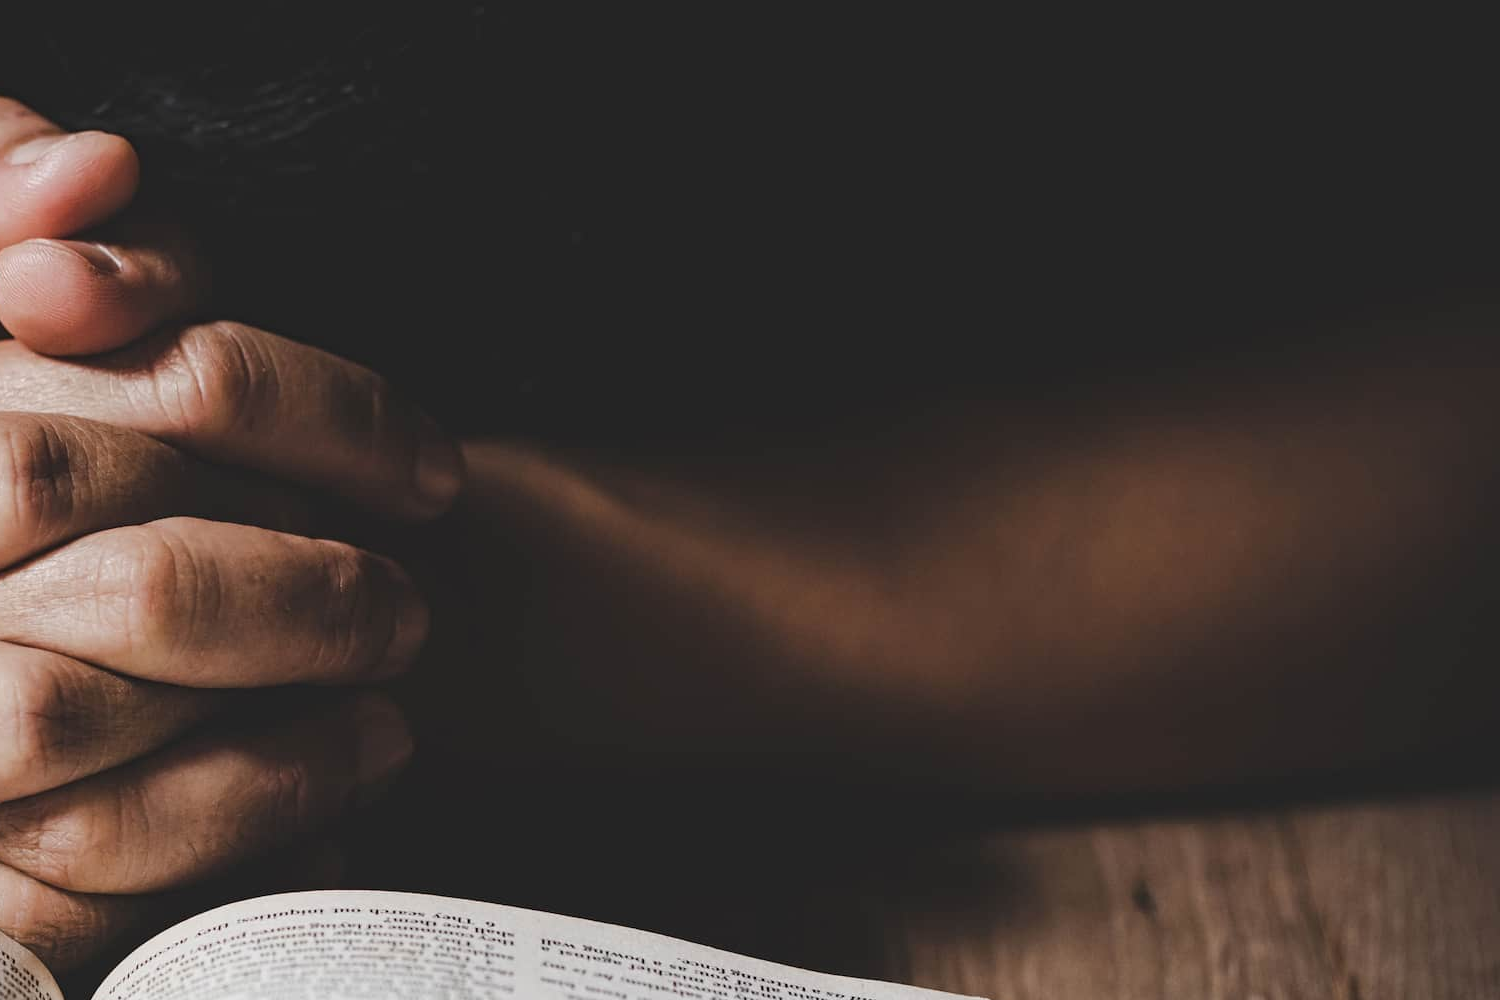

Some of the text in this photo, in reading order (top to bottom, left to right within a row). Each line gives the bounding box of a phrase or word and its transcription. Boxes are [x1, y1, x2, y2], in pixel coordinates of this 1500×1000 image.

[369, 908, 425, 917] search
[433, 913, 471, 924] They
[196, 922, 228, 936] they
[442, 922, 468, 930] see
[474, 926, 514, 938] shall
[540, 937, 575, 949] wall
[558, 949, 622, 965] against
[582, 944, 645, 964] bowing
[669, 963, 686, 971] as
[676, 959, 725, 974] fence.
[630, 963, 704, 983] mischief
[694, 970, 728, 981] you:
[730, 968, 806, 992] tottering
[759, 984, 780, 993] all
[825, 990, 844, 998] as
